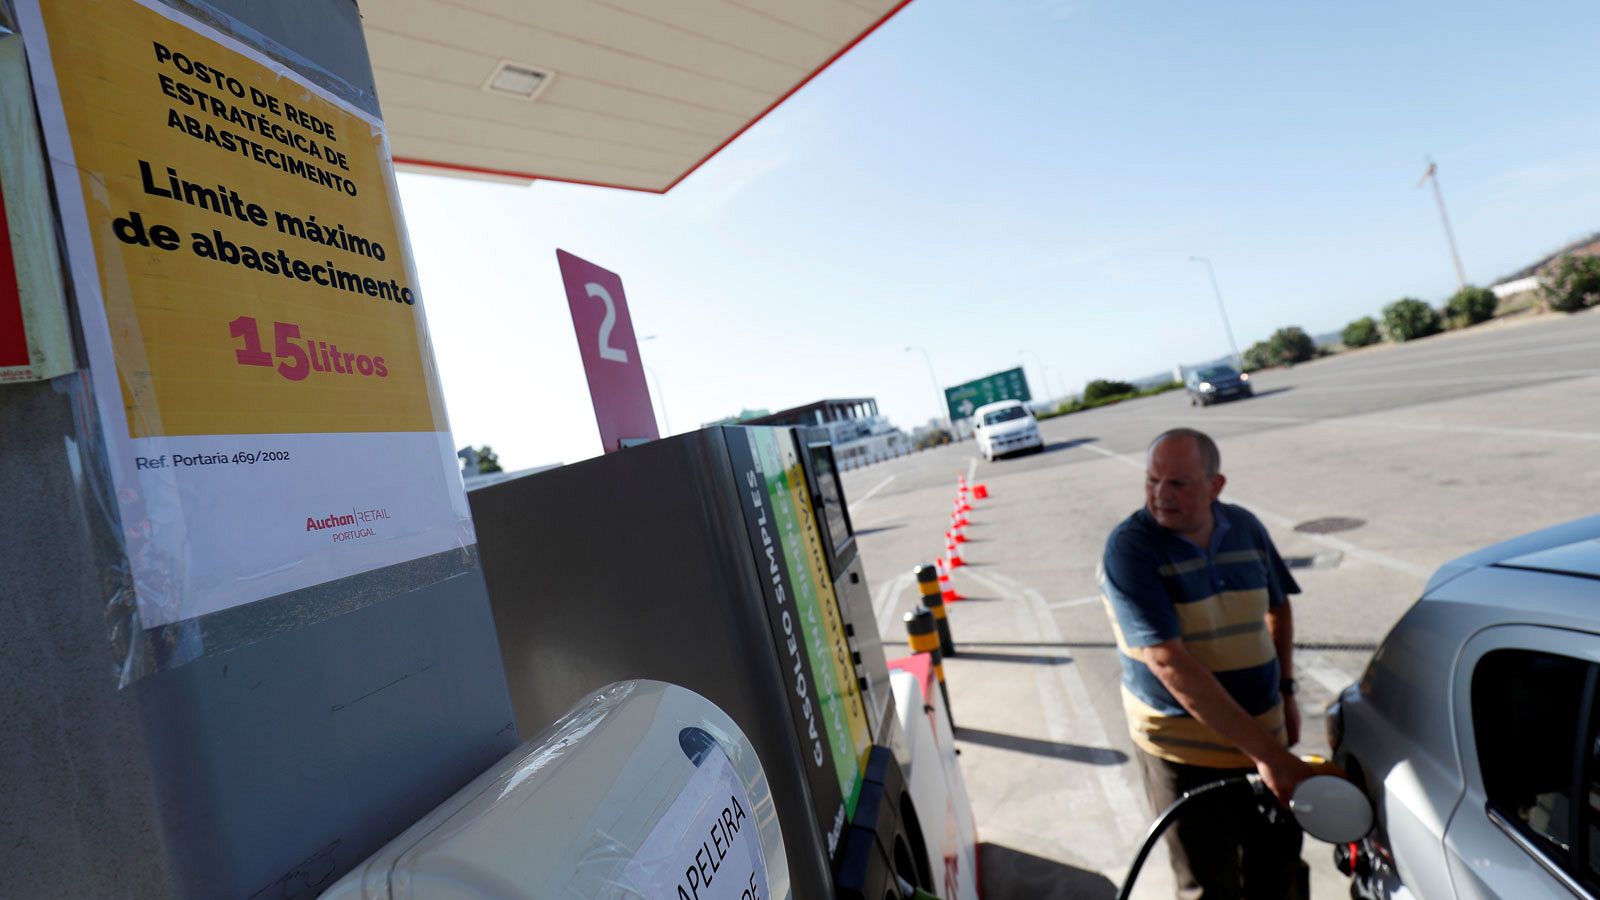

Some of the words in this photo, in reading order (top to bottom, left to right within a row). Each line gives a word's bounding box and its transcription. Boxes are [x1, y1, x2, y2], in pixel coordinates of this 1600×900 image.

[153, 41, 246, 98] POSTO
[250, 86, 282, 116] DE
[284, 102, 337, 141] REDE
[158, 73, 322, 160] ESTRATÉGICA
[324, 146, 350, 171] DE
[168, 108, 357, 197] ABASTECIMENTO
[139, 160, 269, 227] Limite
[274, 210, 386, 261] máximo
[112, 211, 180, 250] de
[191, 230, 415, 306] abastecimento
[584, 282, 629, 364] 2
[135, 454, 170, 471] Ref.
[172, 452, 229, 467] Portaria
[231, 450, 290, 466] 469/2002
[306, 513, 355, 532] Auchan
[332, 527, 376, 543] PORTUGAL
[746, 470, 786, 605] SIMPLES
